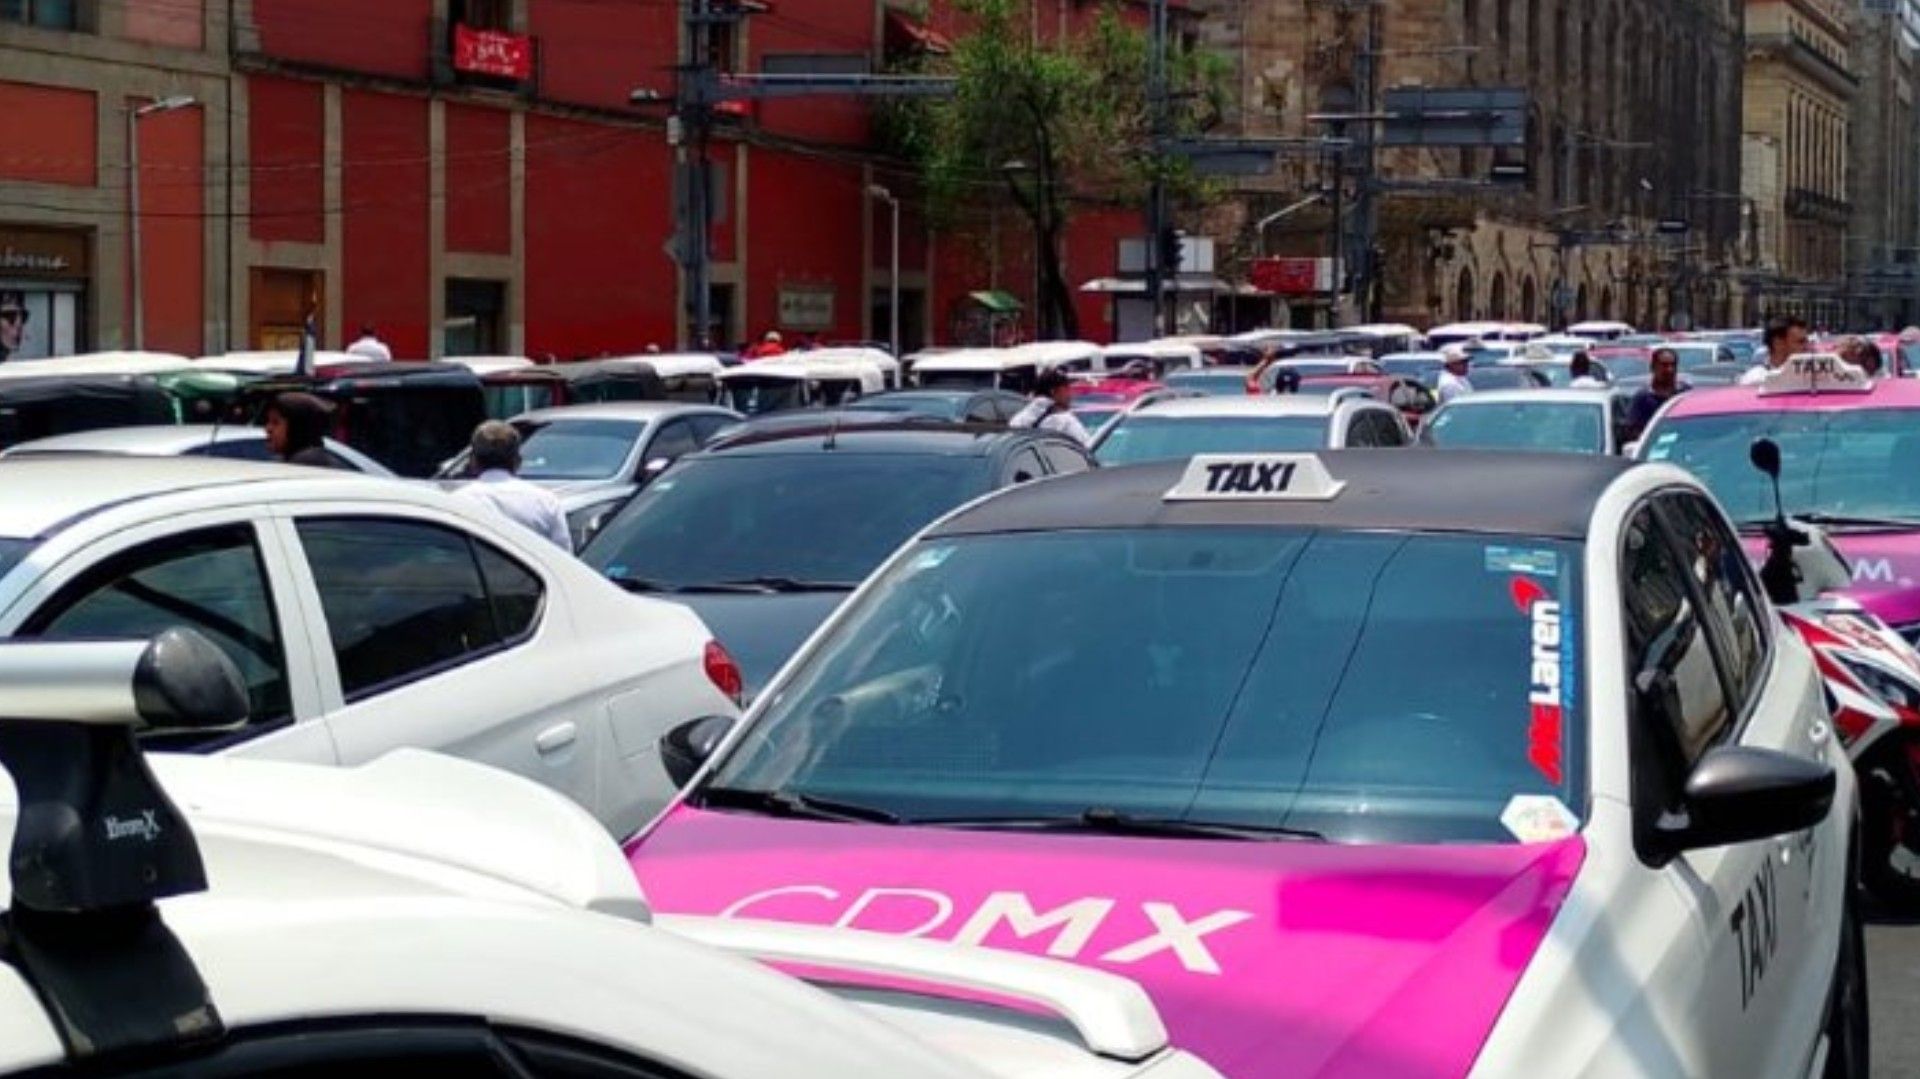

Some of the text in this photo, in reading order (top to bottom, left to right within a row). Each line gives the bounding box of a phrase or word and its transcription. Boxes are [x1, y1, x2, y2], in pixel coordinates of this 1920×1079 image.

[1792, 359, 1835, 374] TAXI
[1206, 462, 1297, 492] TAXI
[716, 885, 1256, 975] CDMX
[1730, 853, 1777, 1012] TAXI
